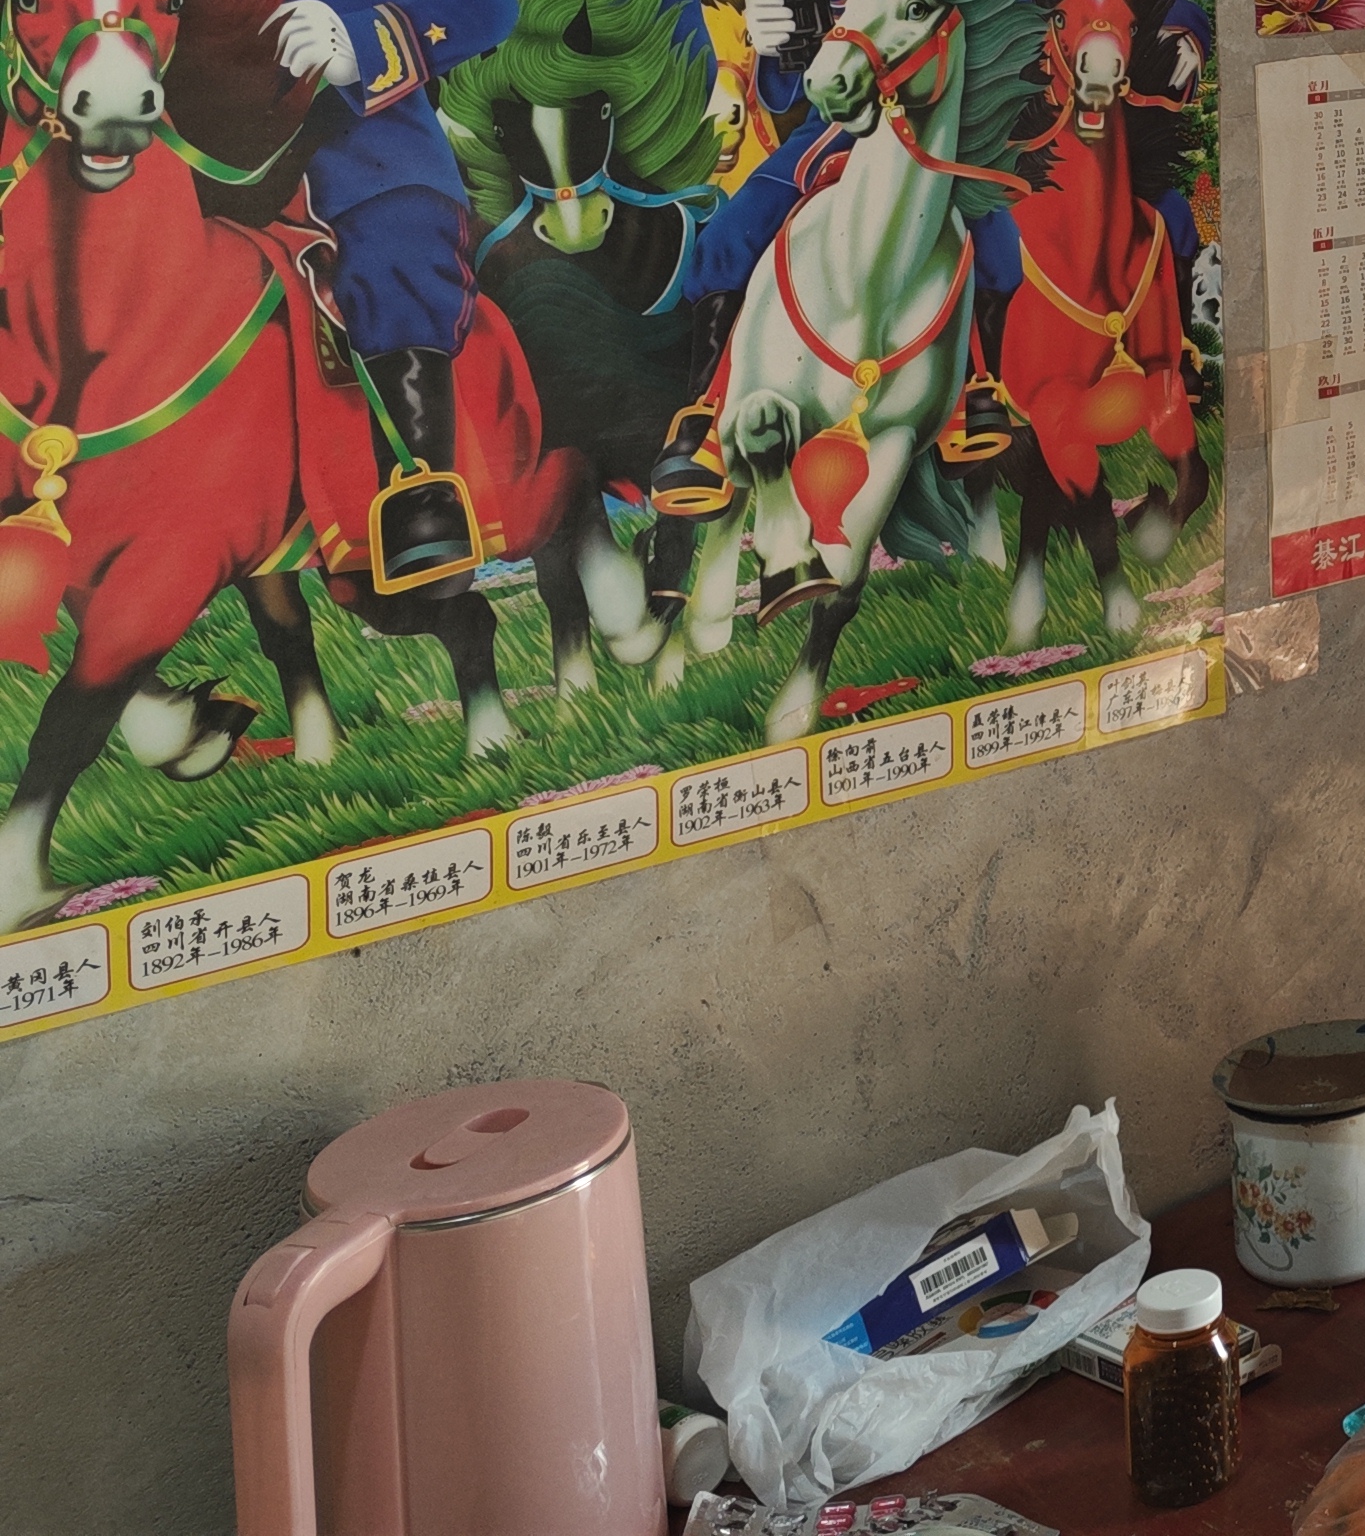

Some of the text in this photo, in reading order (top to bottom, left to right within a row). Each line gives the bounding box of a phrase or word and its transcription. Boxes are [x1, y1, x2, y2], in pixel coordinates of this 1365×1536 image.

[1318, 373, 1340, 386] 玖月
[971, 707, 1079, 741] 四川省江津县人
[972, 705, 1018, 728] 聂荣臻
[827, 738, 878, 763] 徐向前
[828, 741, 946, 779] 山西省五台县人
[678, 776, 802, 818] 湖南省衡山县人
[680, 777, 731, 803] 罗荣桓
[516, 822, 554, 844] 陈毅
[516, 817, 652, 859] 四川省乐至县人
[334, 866, 375, 891] 贺龙
[335, 860, 484, 907] 湖南省桑植县人
[141, 908, 211, 939] 刘伯承
[141, 912, 281, 954] 四川省开县人
